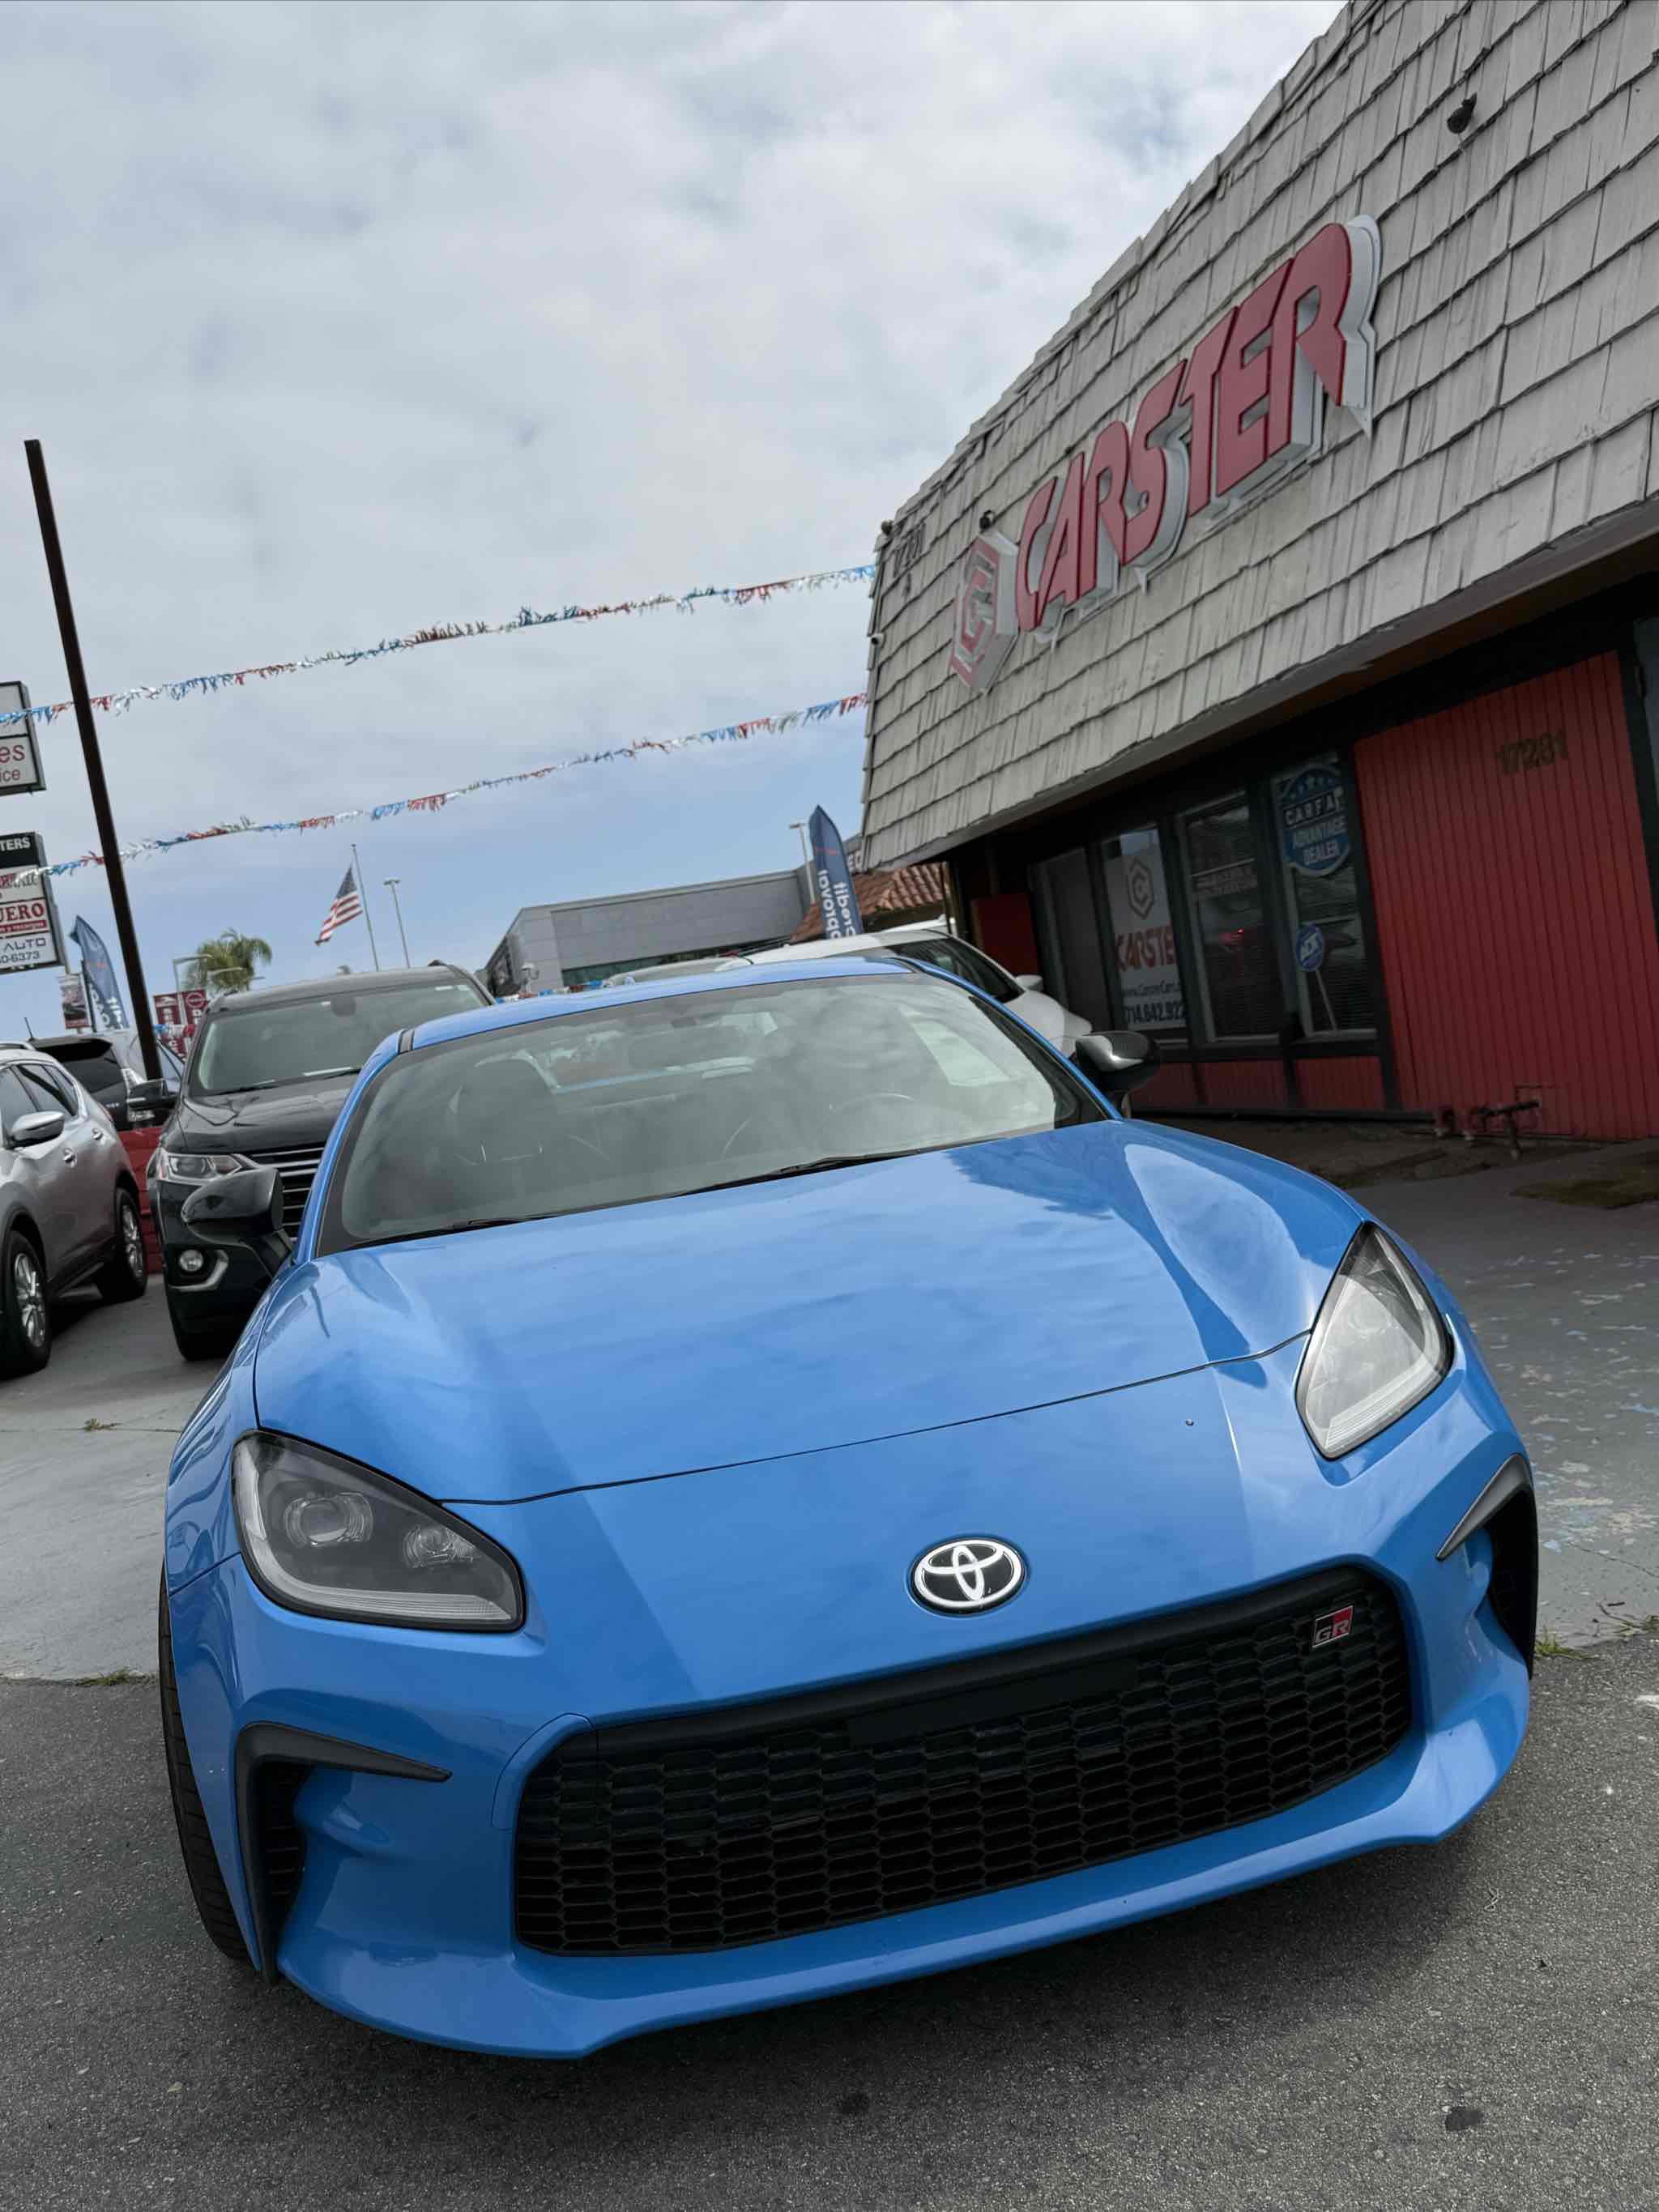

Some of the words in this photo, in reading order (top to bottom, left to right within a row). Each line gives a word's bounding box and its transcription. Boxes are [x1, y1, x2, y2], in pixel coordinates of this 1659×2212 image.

[1015, 219, 1369, 633] CARSTER
[4, 937, 46, 953] AUTO
[1316, 1619, 1349, 1643] GR
